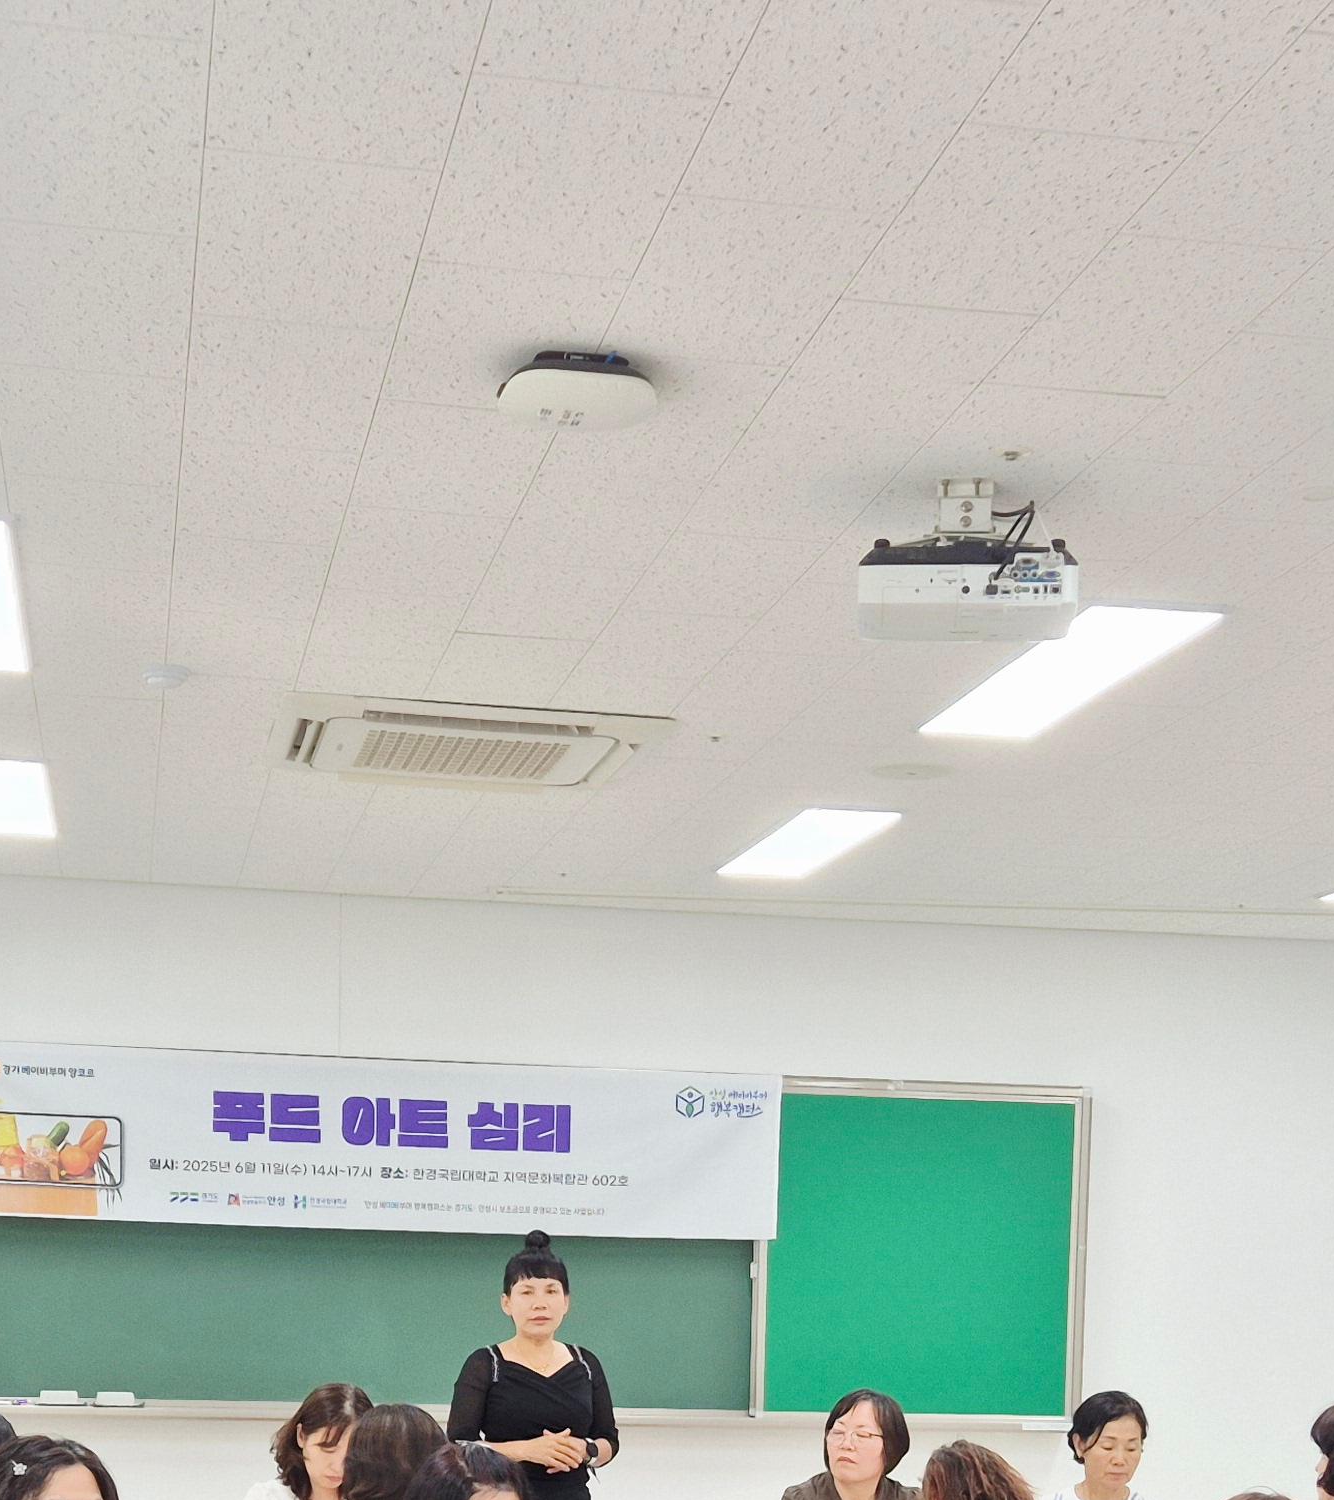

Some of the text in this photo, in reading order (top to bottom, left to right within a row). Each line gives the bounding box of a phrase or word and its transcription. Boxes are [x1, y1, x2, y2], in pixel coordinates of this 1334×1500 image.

[2, 1064, 20, 1075] 경기
[21, 1065, 67, 1078] 베이비부머
[68, 1067, 96, 1079] 앙코르
[212, 1090, 572, 1154] 푸드 아트 심리
[149, 1158, 179, 1171] 일시:
[183, 1159, 231, 1174] 2025년
[235, 1161, 257, 1175] 6월
[380, 1166, 409, 1180] 장소:
[413, 1168, 499, 1183] 한경국립대학교
[592, 1174, 630, 1188] 602호
[267, 1195, 286, 1207] 안성
